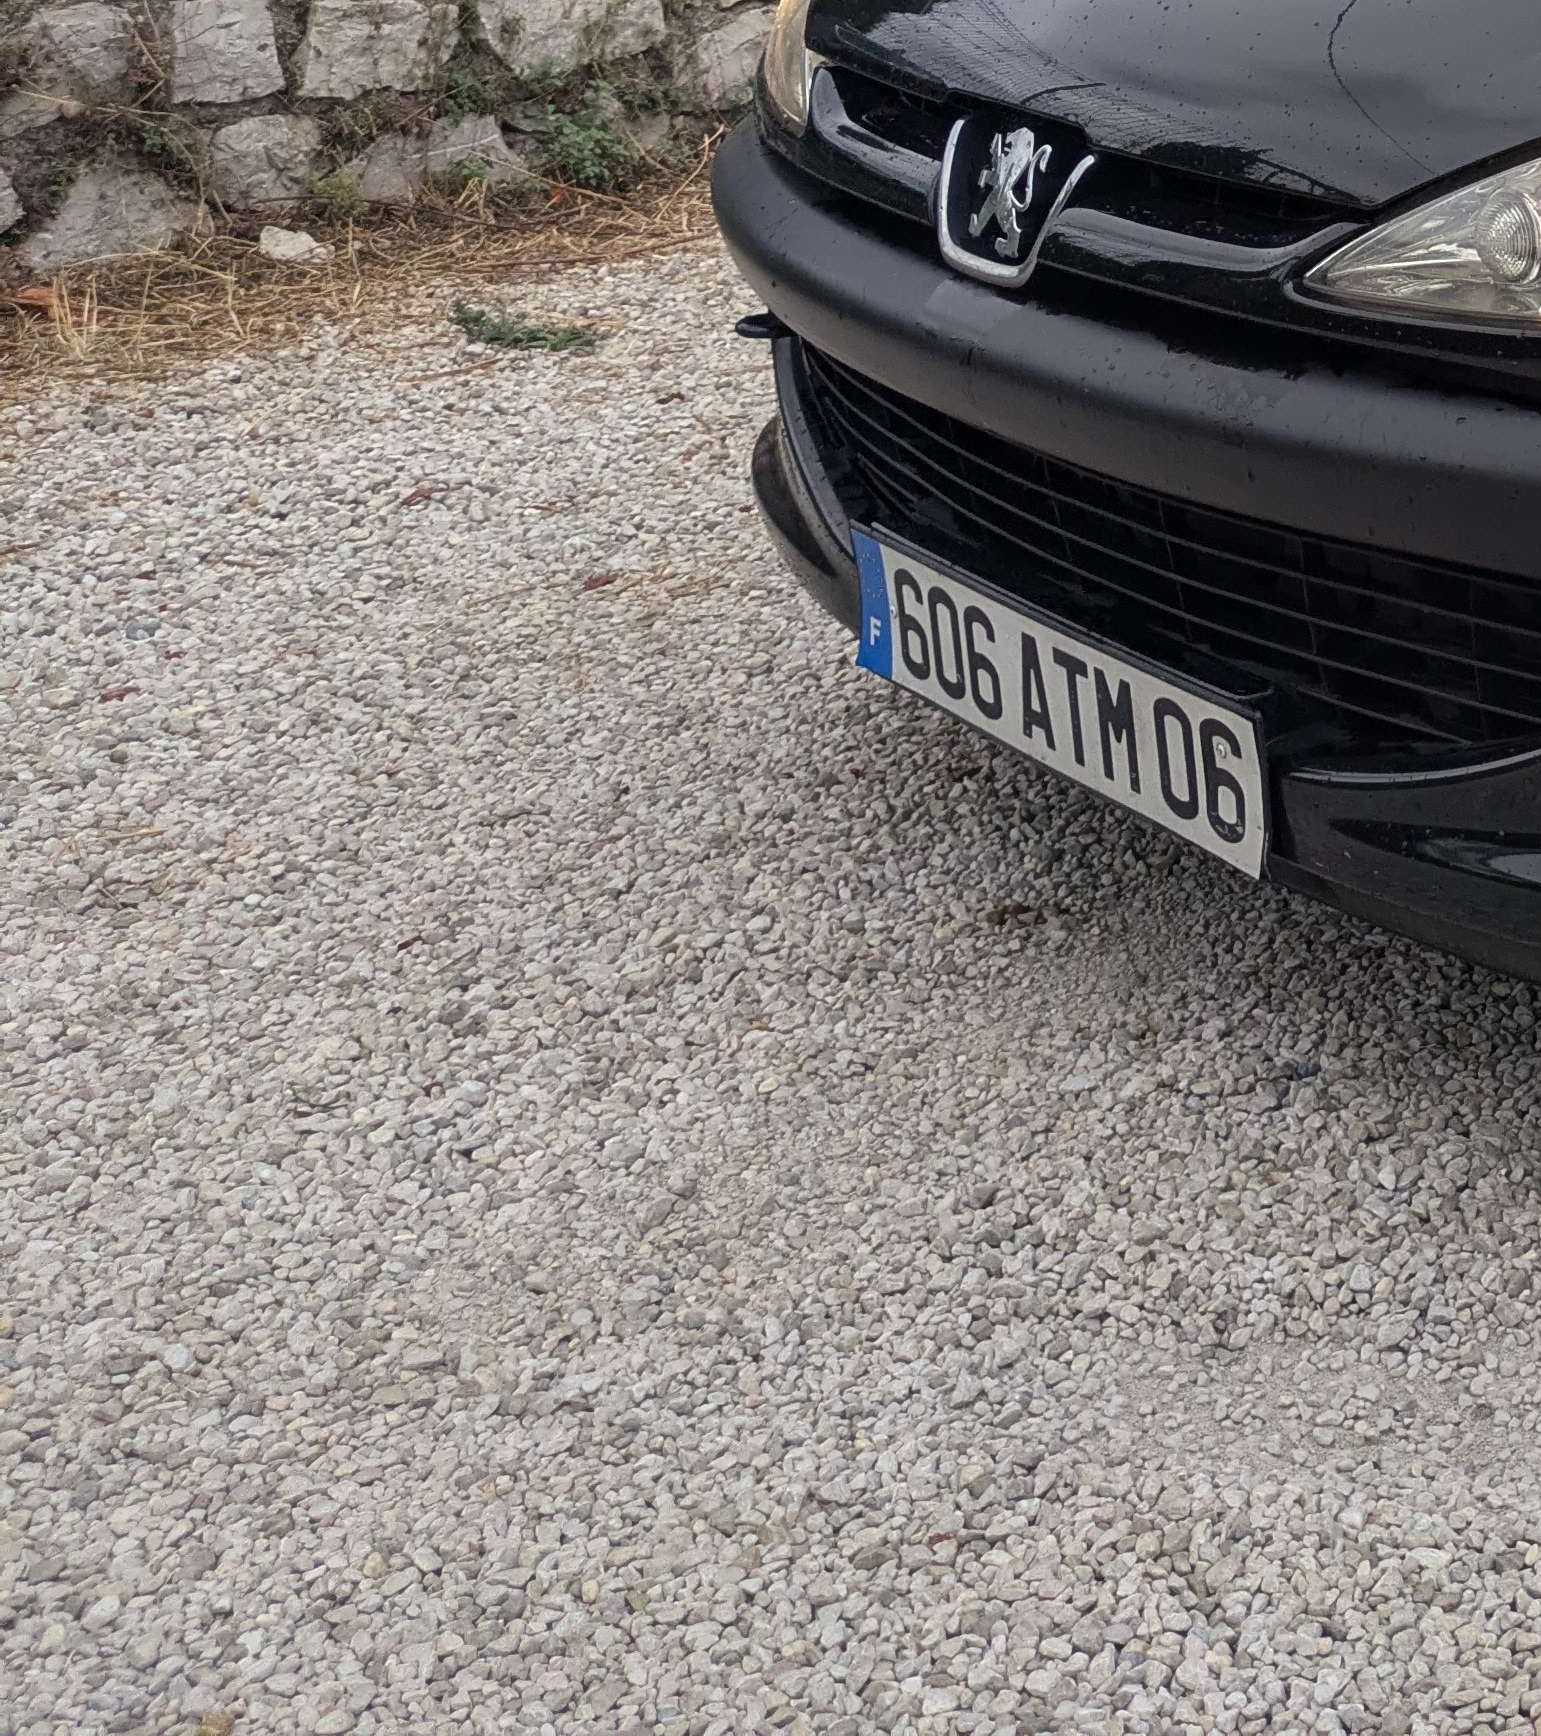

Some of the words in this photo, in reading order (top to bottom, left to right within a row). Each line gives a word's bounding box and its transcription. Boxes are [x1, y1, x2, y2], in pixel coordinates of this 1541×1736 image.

[868, 617, 882, 647] F
[893, 567, 1003, 721] 606
[1020, 631, 1141, 794] ATM
[1152, 697, 1246, 844] 06
